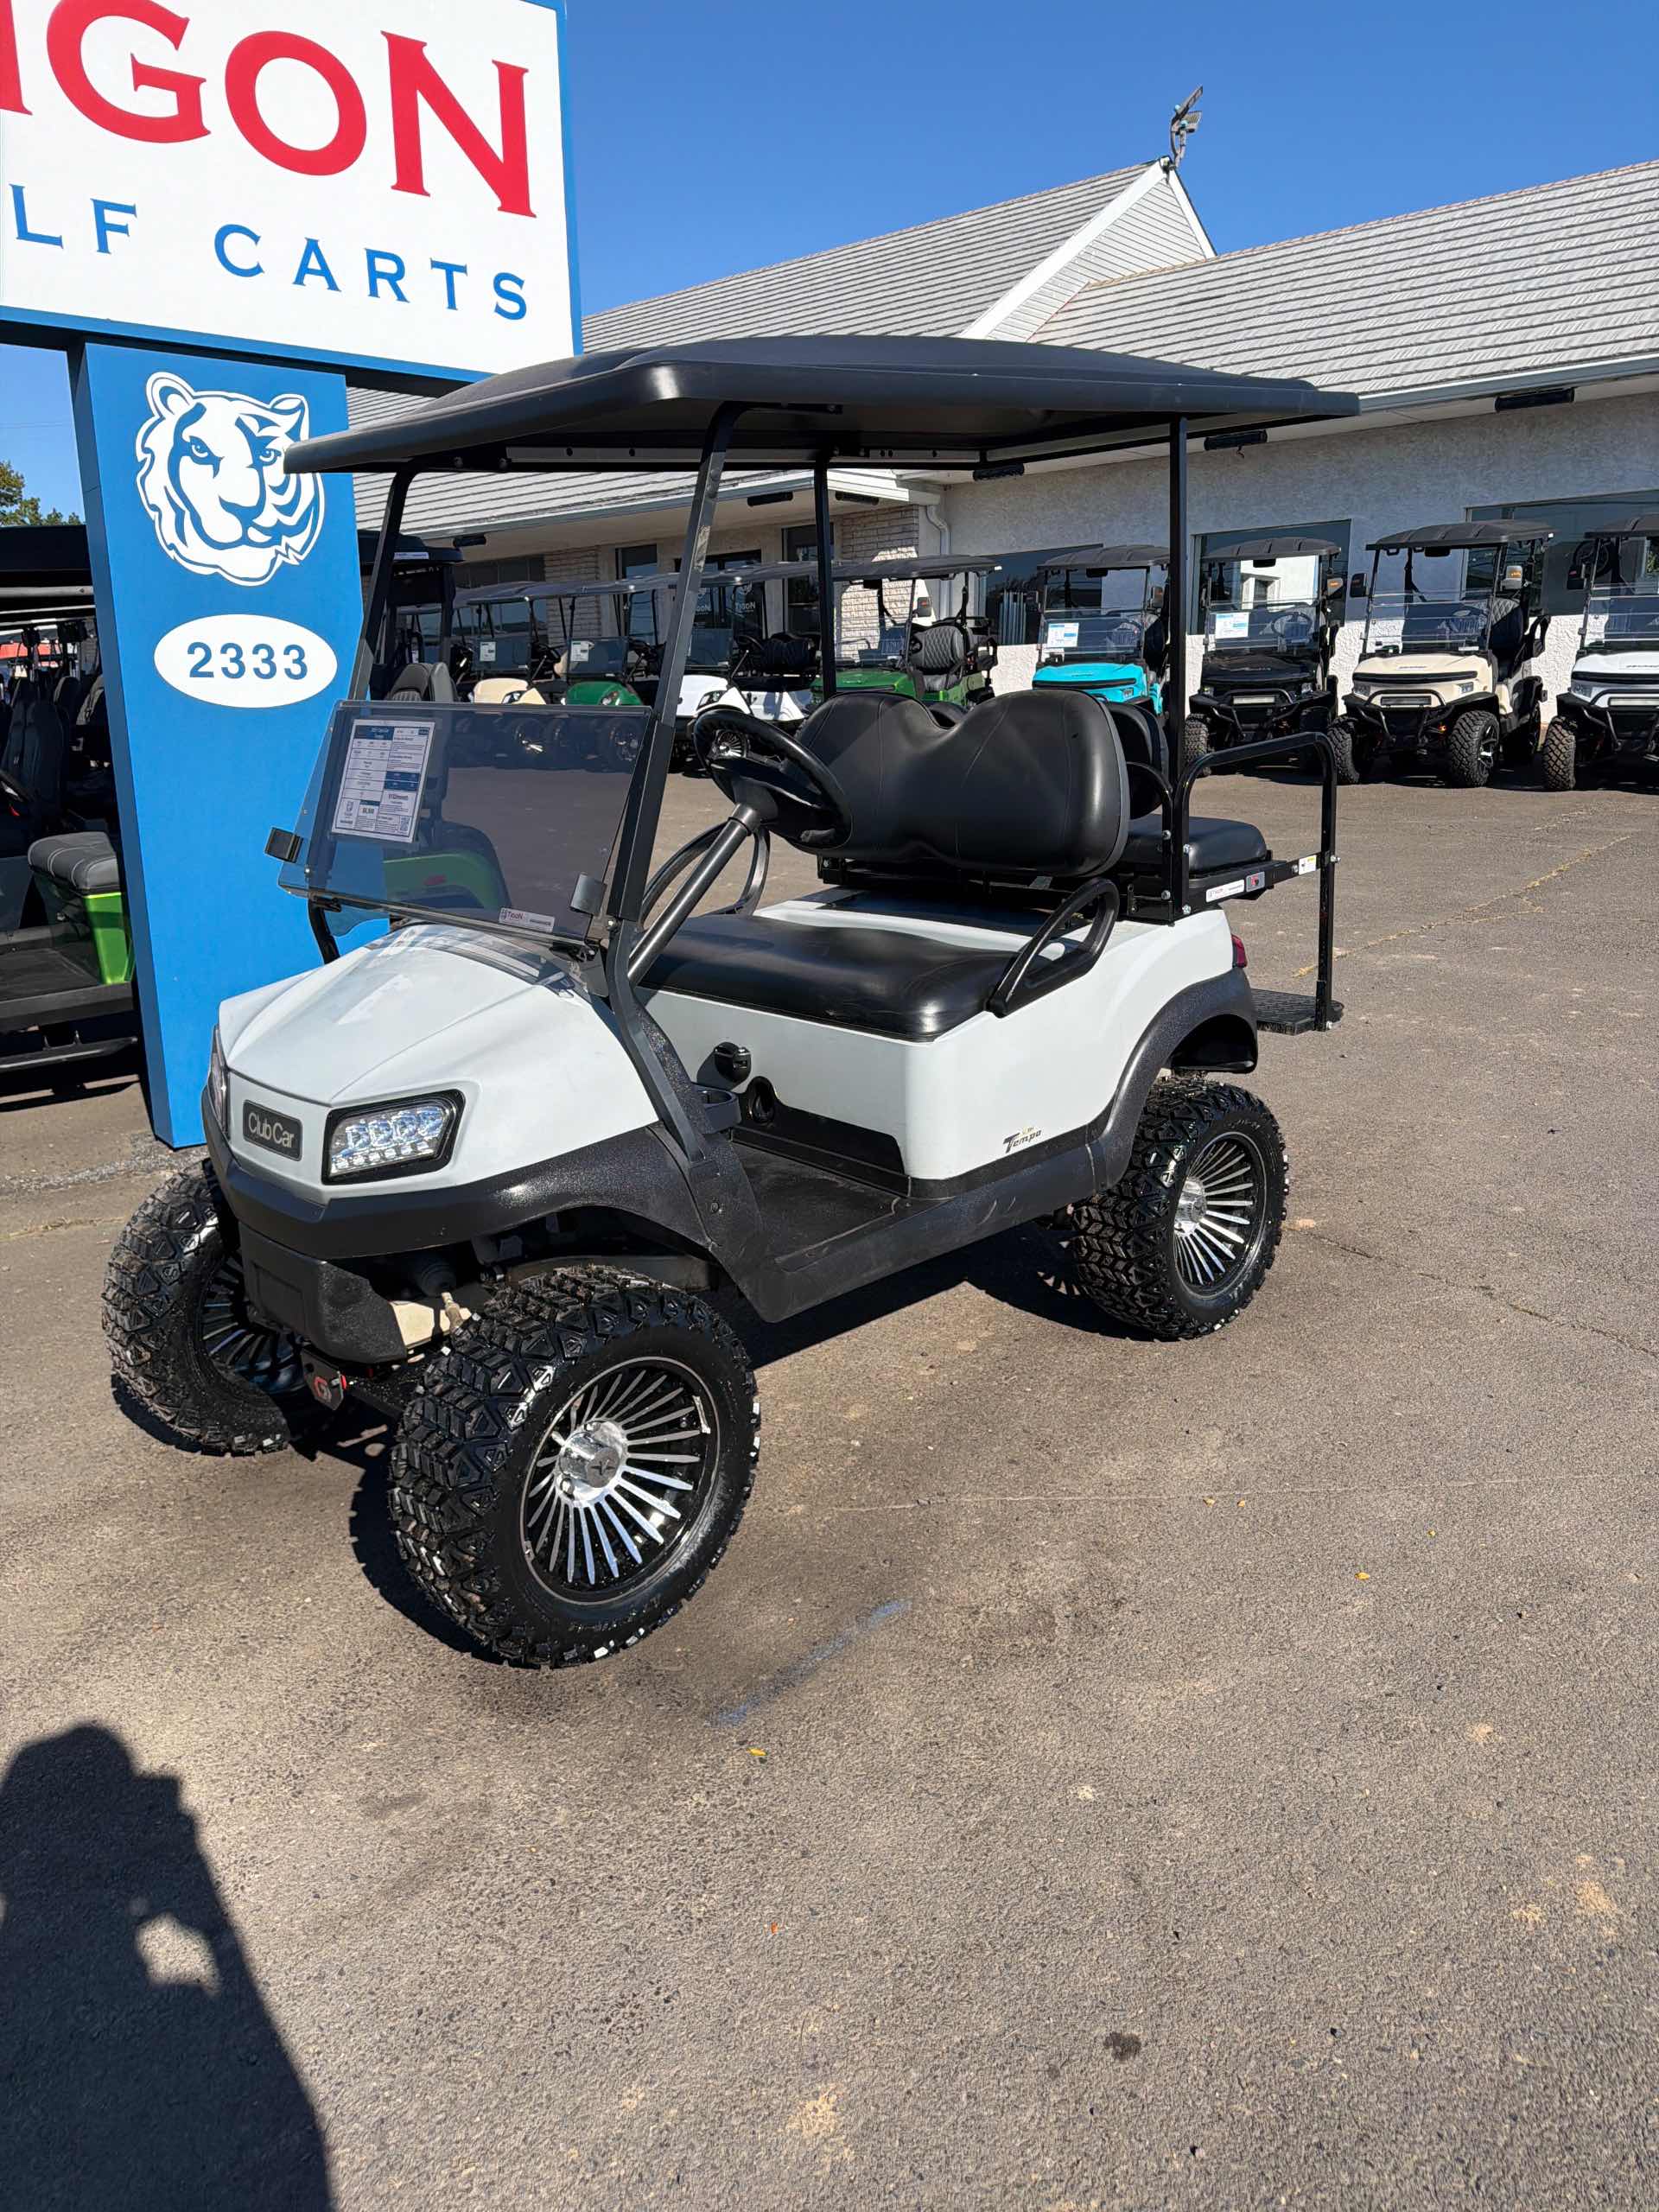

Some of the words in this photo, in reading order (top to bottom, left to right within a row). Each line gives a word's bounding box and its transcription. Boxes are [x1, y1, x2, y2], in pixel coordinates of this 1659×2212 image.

[213, 224, 527, 321] CARTS
[187, 641, 308, 680] 2333
[248, 1112, 271, 1141] Club
[272, 1122, 295, 1148] Car
[1002, 1129, 1042, 1154] Tempo
